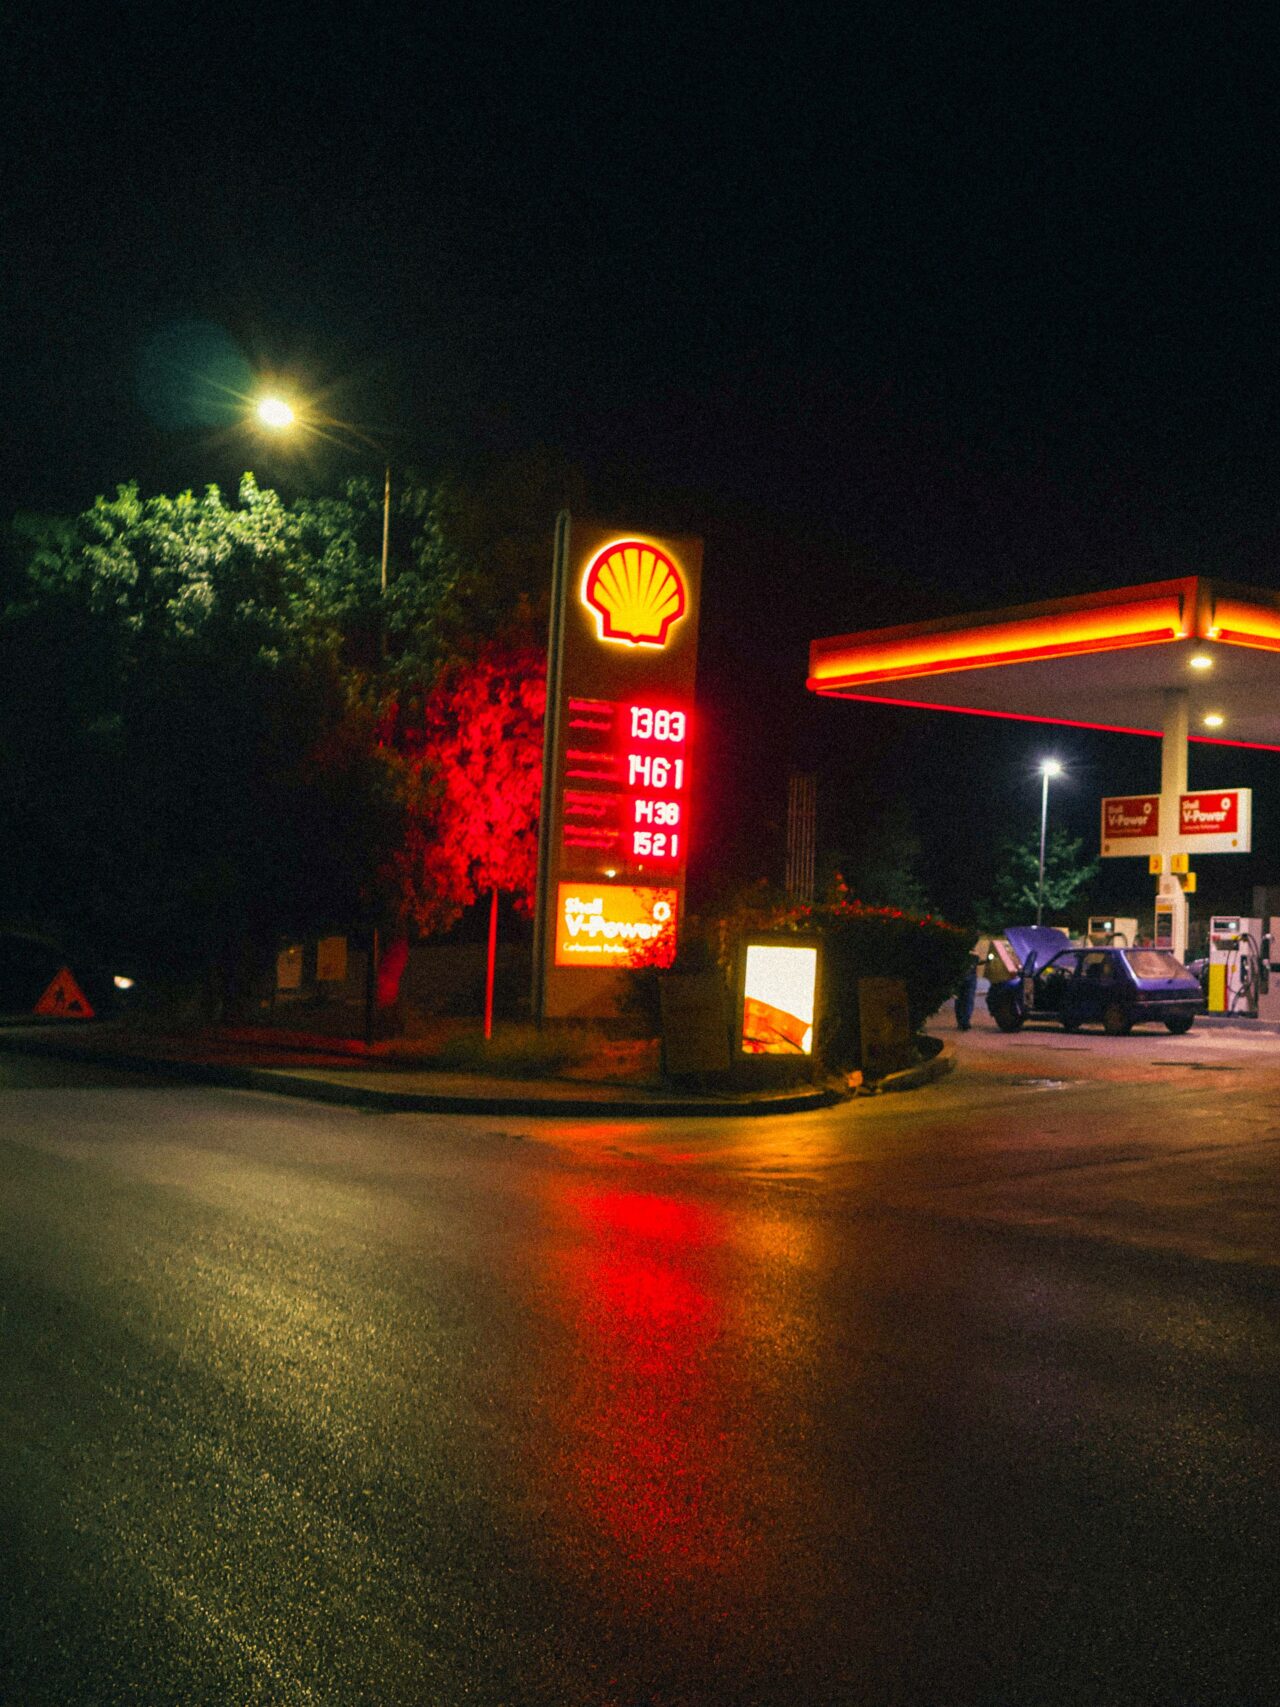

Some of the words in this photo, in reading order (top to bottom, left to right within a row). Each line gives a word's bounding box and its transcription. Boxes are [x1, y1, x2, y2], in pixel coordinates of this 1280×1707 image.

[630, 706, 686, 742] 1383
[628, 754, 683, 790] 1461
[635, 799, 680, 826] 1438
[1182, 799, 1200, 810] Shell
[1183, 809, 1228, 823] V-Power
[1108, 813, 1149, 827] V-Power
[633, 831, 678, 858] 1521
[565, 913, 663, 940] V-Power
